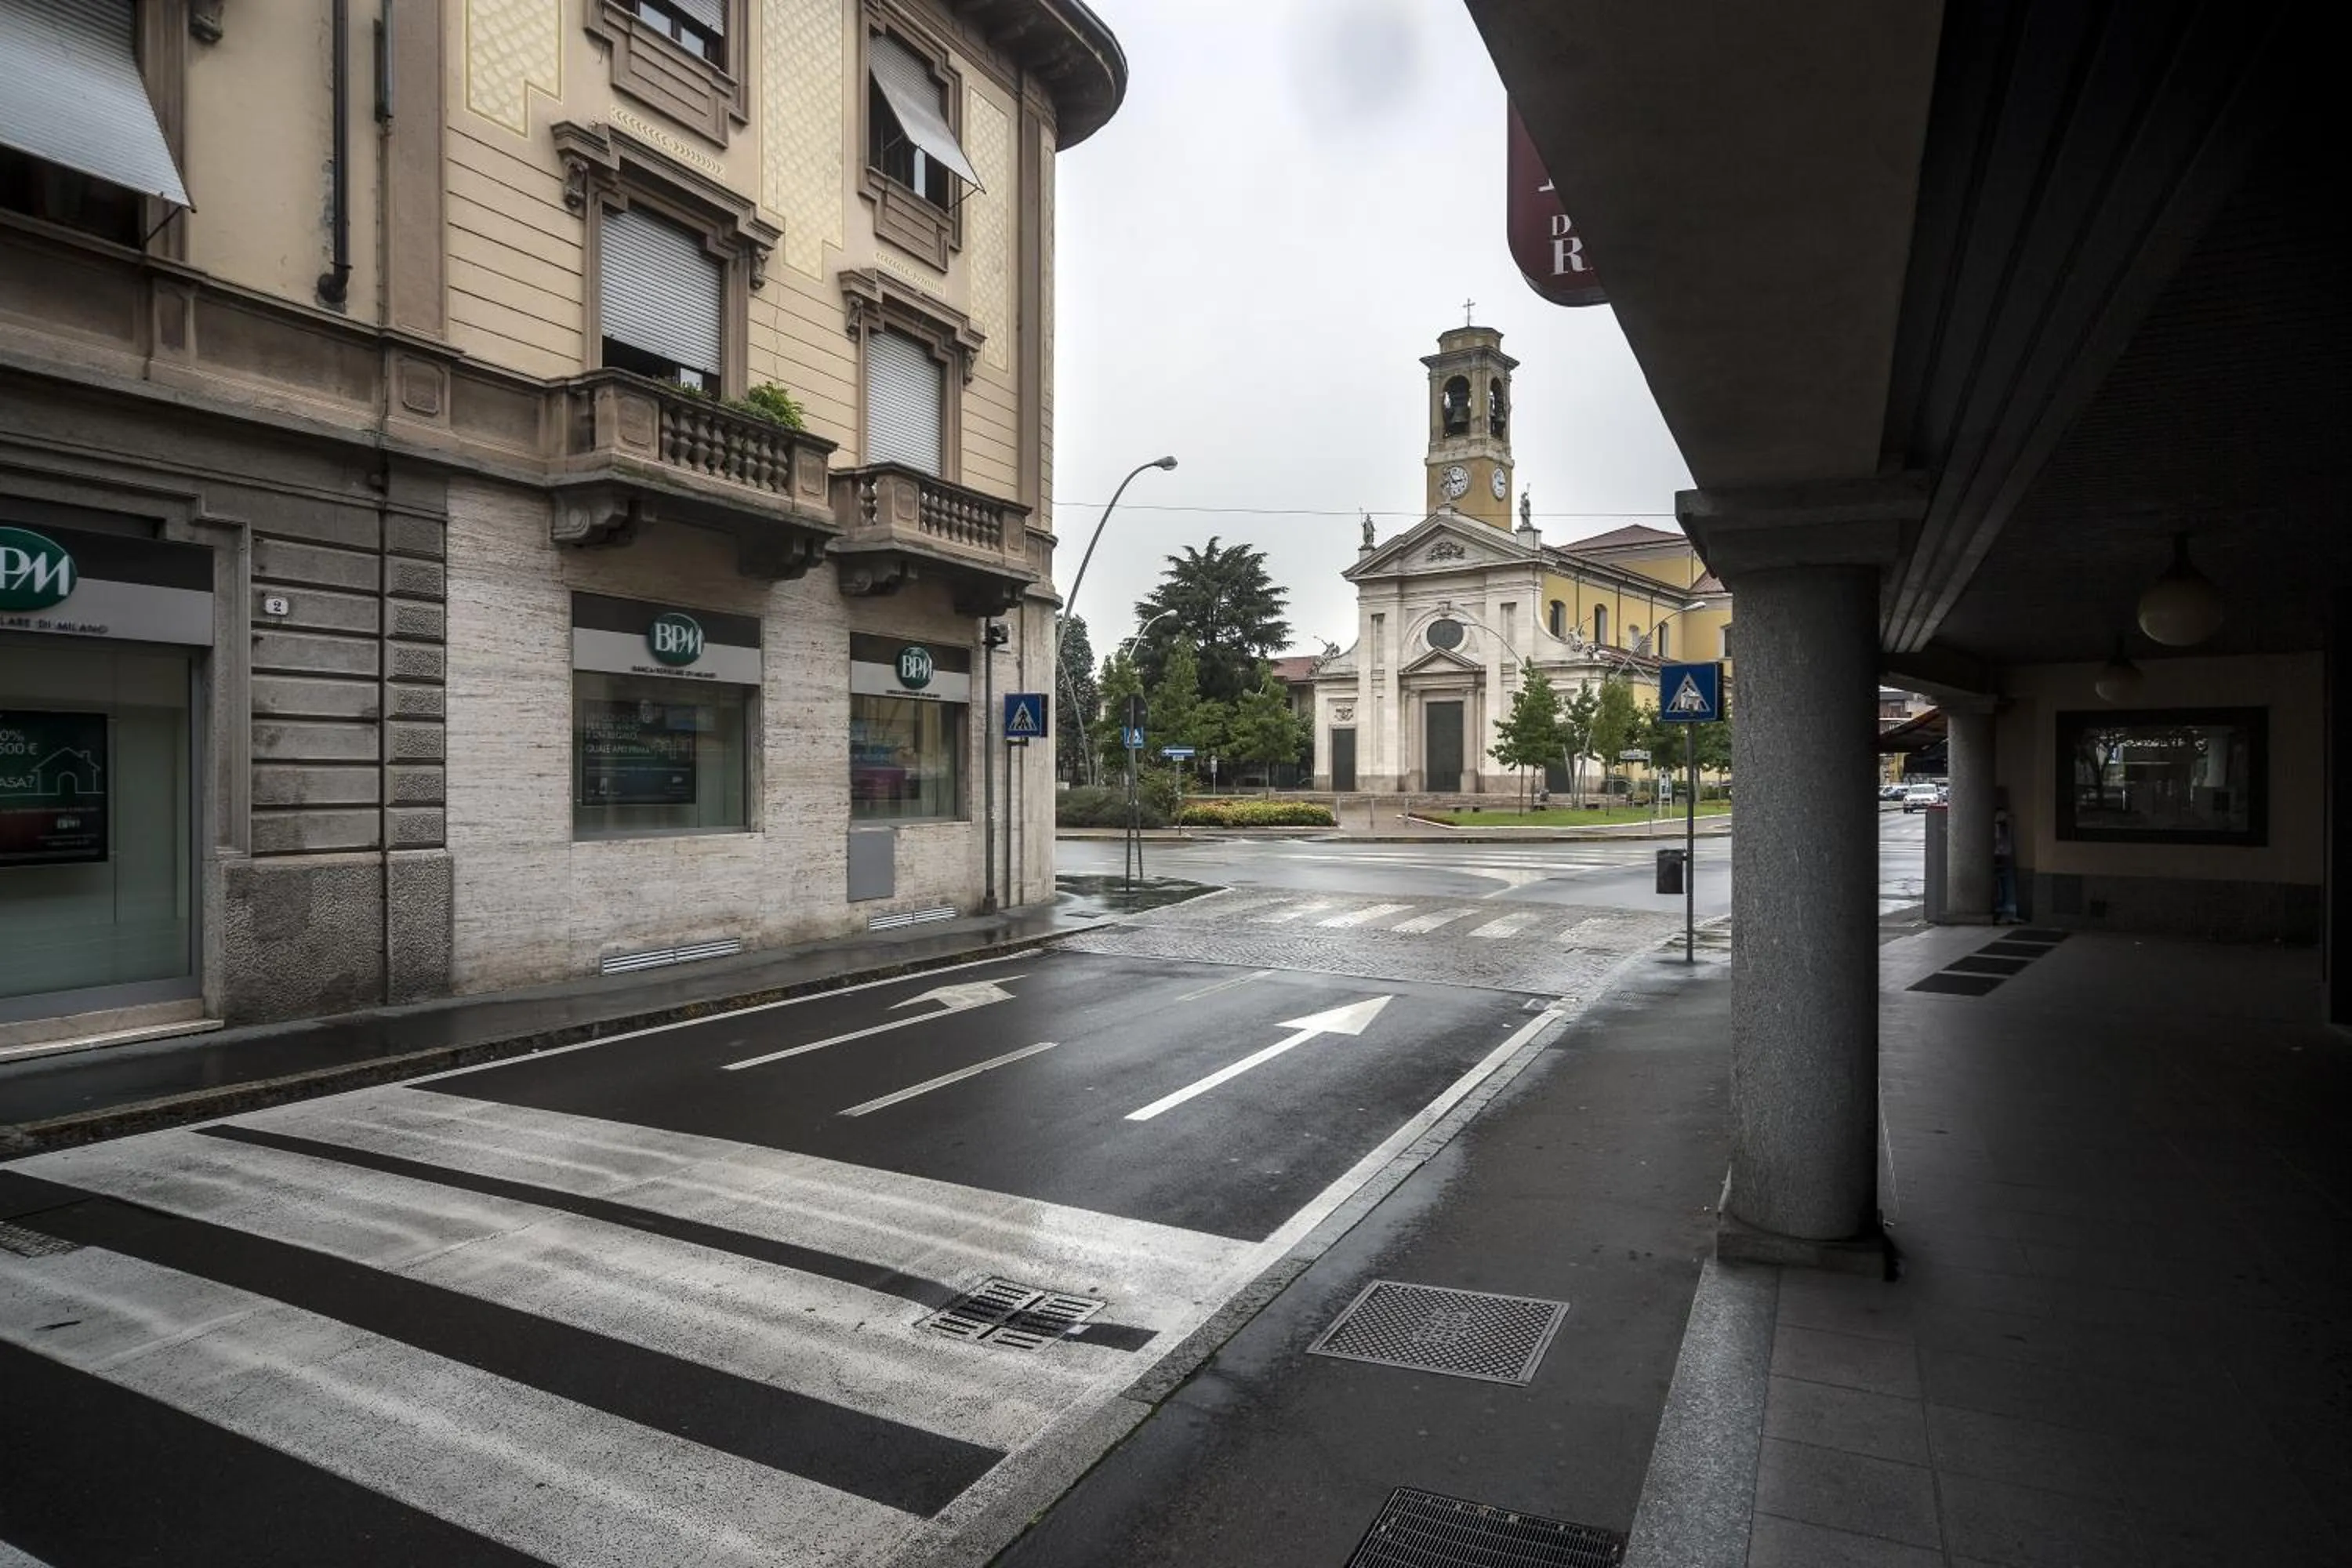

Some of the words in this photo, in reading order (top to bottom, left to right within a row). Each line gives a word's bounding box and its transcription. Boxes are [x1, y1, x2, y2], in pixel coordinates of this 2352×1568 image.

[274, 600, 281, 612] 2
[38, 619, 51, 628] DI
[57, 621, 108, 633] MILANO
[654, 622, 703, 655] BPM
[901, 655, 932, 679] BPM
